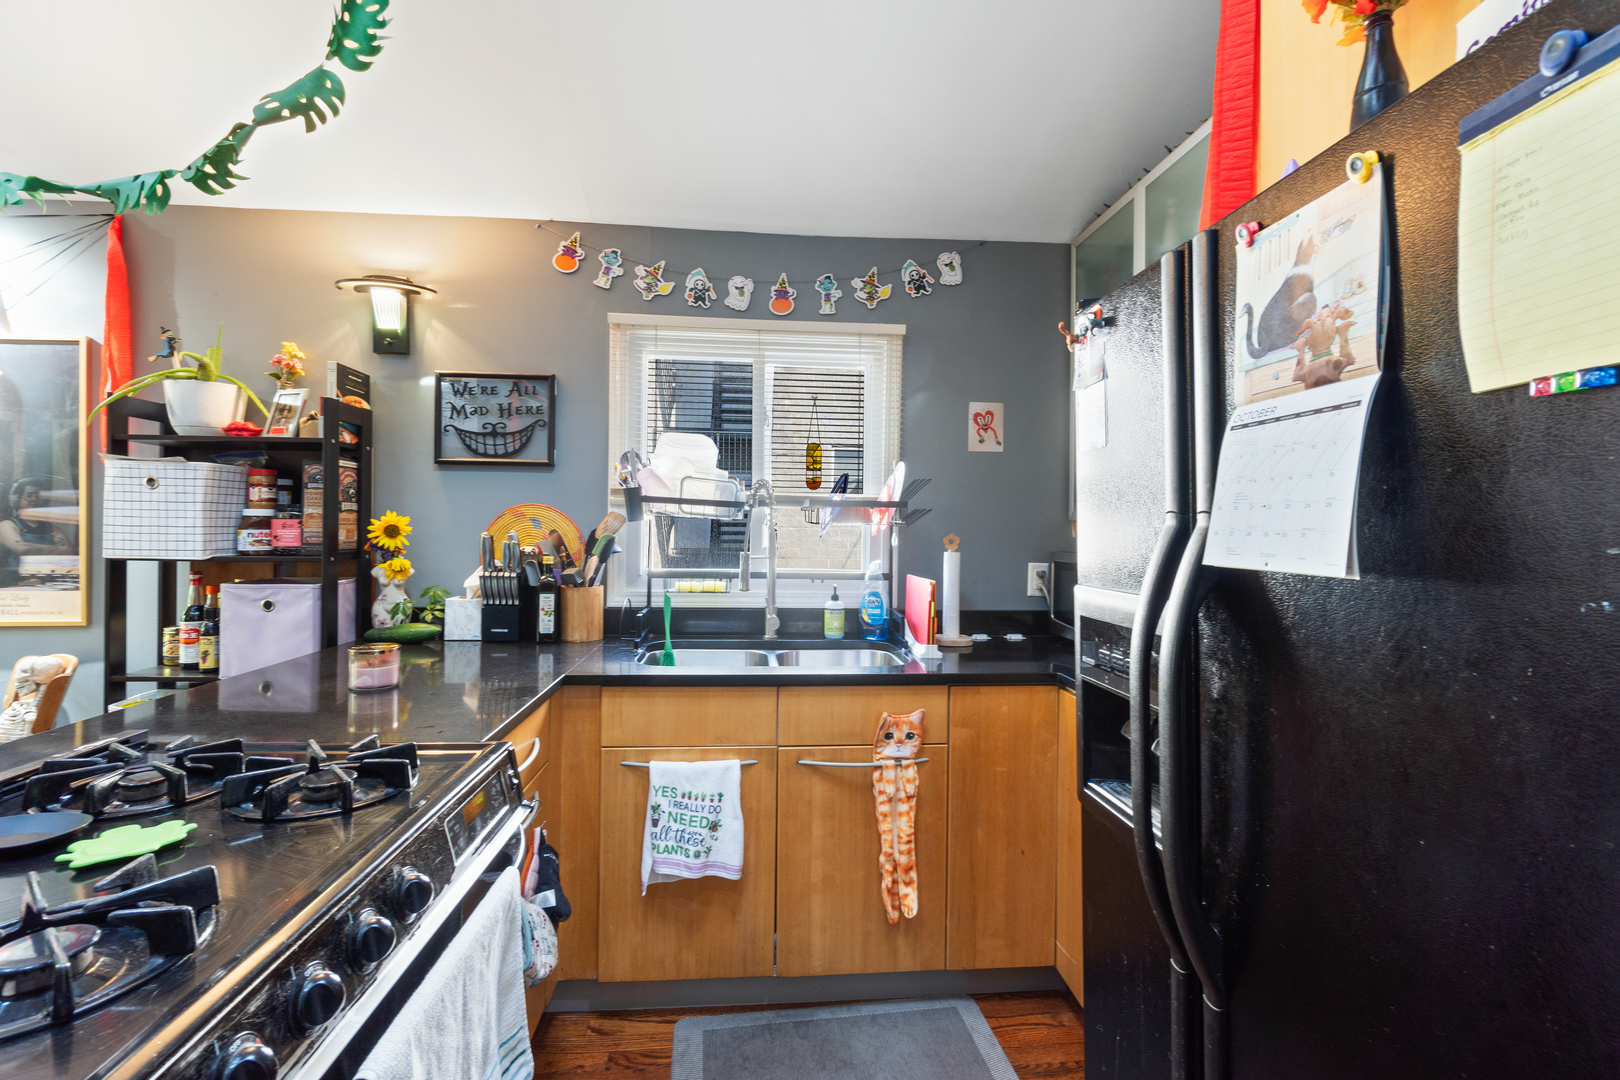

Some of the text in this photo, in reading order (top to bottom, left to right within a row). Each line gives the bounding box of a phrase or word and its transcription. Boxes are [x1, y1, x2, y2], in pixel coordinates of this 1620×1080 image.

[1496, 228, 1529, 244] turkey
[496, 402, 545, 420] HERE
[1233, 406, 1278, 424] OCTOBER
[247, 530, 272, 538] nutel
[652, 785, 678, 798] YES
[668, 800, 722, 814] I REALLY DO
[667, 811, 710, 829] NEED
[650, 825, 706, 848] all these
[652, 842, 690, 858] PLANTS
